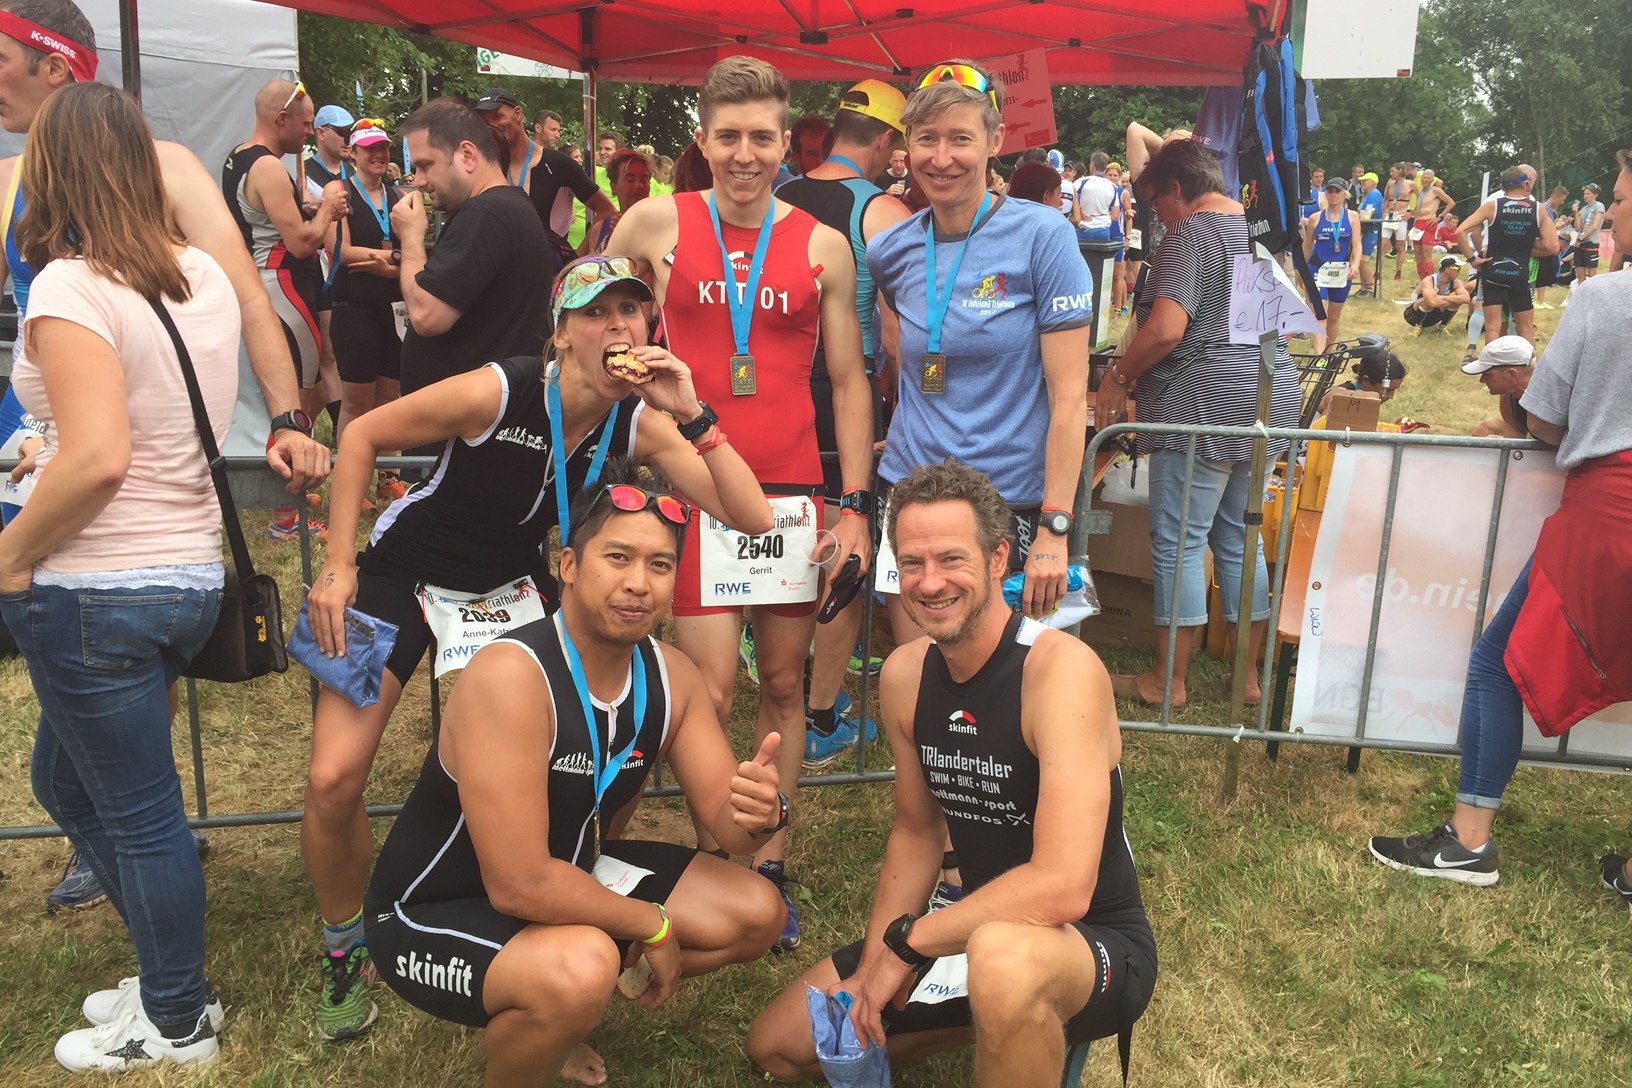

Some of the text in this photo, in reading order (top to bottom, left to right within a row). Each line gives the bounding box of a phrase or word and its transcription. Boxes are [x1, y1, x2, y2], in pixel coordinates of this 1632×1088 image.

[760, 286, 789, 315] 01
[737, 534, 784, 560] 2540
[749, 566, 773, 575] Gerrit
[715, 582, 752, 595] RWE
[948, 722, 978, 736] skinfit
[920, 744, 1013, 779] TRIandertaler
[930, 771, 1001, 795] SWIM BIKE RUN
[395, 950, 473, 998] skinfit
